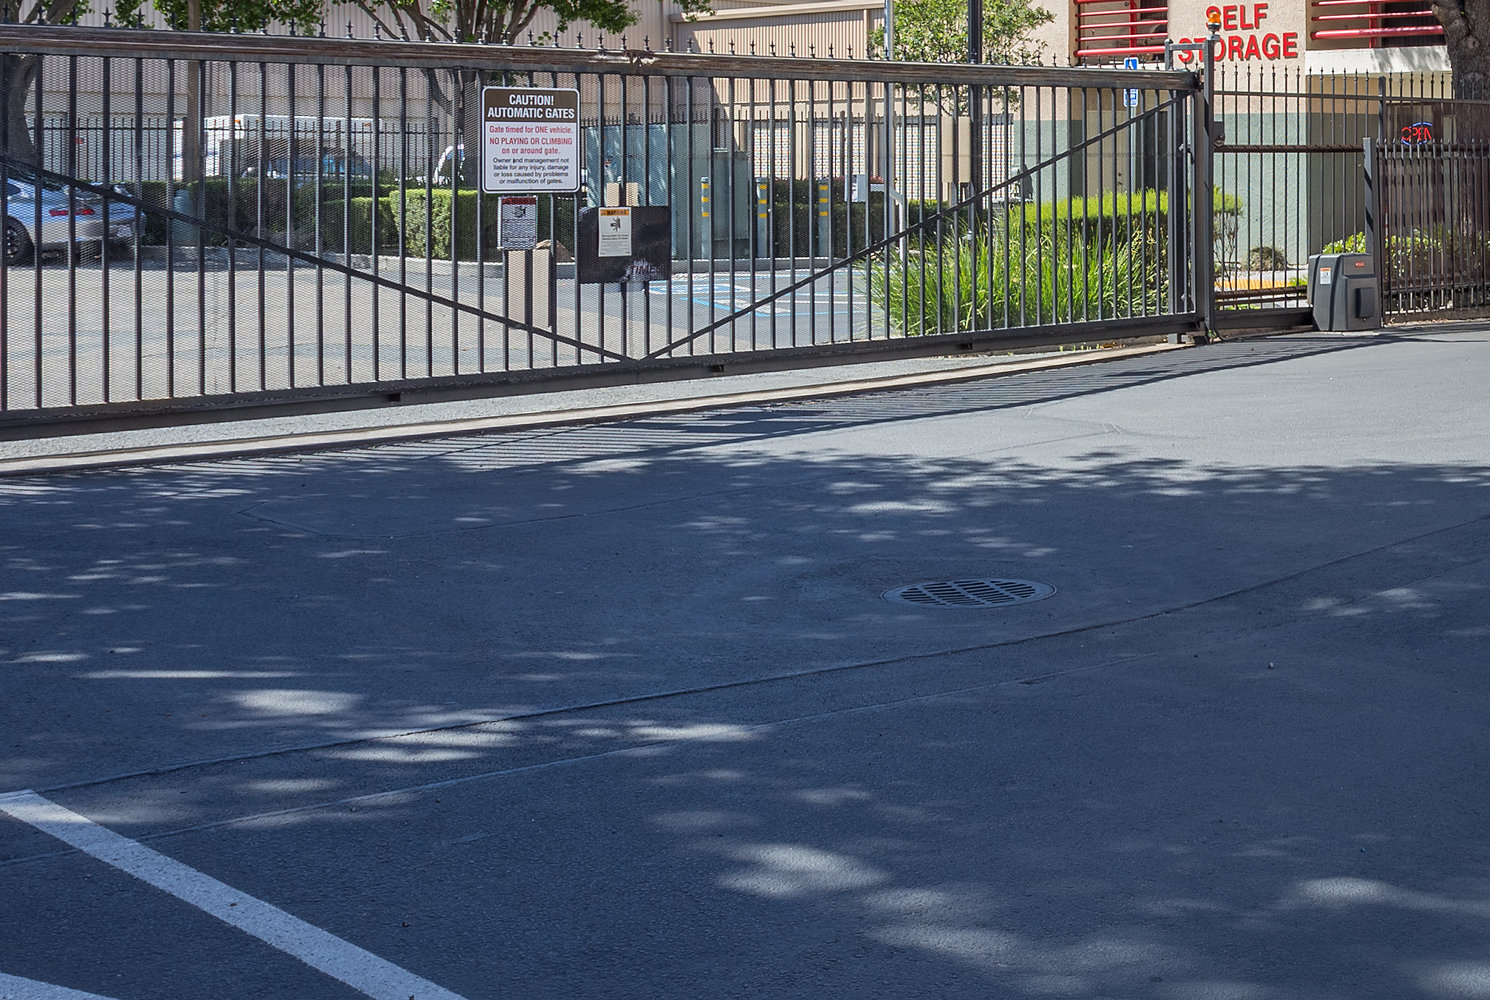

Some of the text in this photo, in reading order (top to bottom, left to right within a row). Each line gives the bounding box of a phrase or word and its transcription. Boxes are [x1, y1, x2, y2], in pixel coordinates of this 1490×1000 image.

[1178, 32, 1298, 63] STORAGE
[509, 94, 554, 106] CAUTION!
[487, 107, 575, 119] AUTOMATIC GATES
[489, 125, 504, 133] Gate
[505, 125, 524, 133] timed
[525, 125, 534, 133] for
[549, 126, 574, 134] vehicle.
[1401, 127, 1432, 141] OPEN
[489, 137, 573, 145] NO PLAYING OR CLIMBING
[544, 147, 561, 155] gate.
